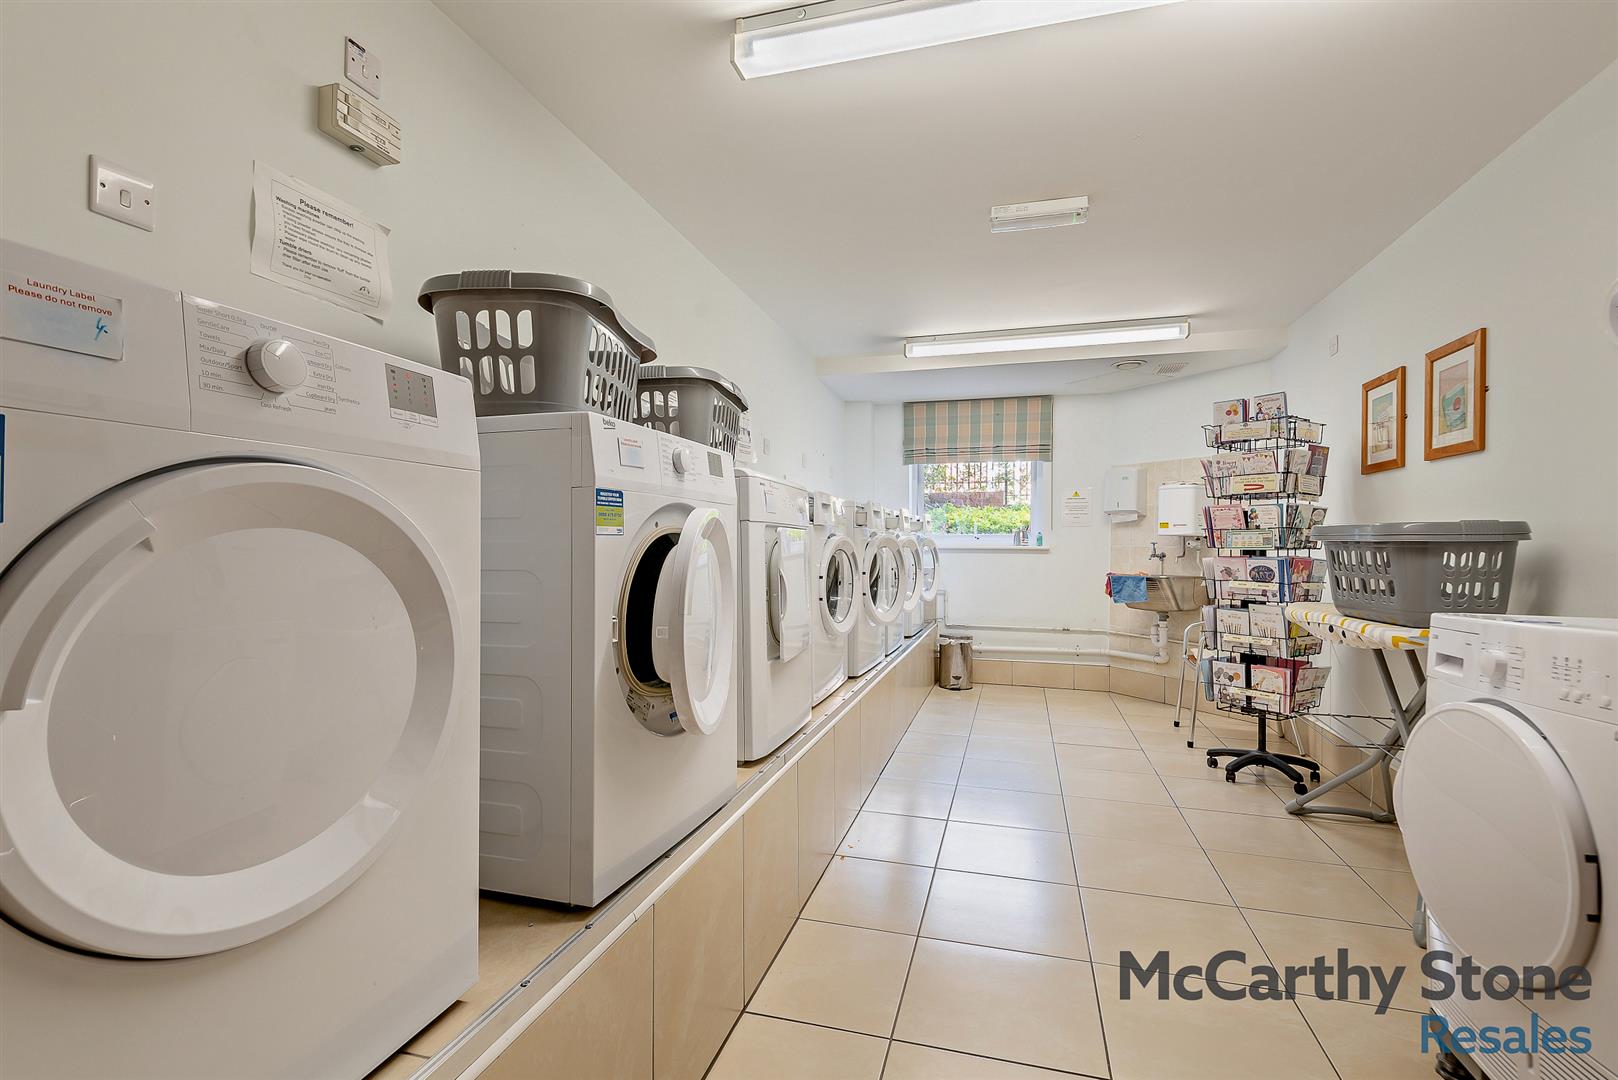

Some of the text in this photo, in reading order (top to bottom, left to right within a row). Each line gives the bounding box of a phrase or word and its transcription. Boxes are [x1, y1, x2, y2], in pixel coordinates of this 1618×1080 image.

[276, 195, 297, 209] Washing
[299, 198, 321, 213] Please
[322, 210, 354, 228] remember!
[279, 238, 297, 249] Tumble
[27, 278, 96, 302] Laundry Label
[8, 285, 113, 316] Please do not remove
[200, 331, 221, 342] Towels
[199, 344, 226, 356] Mix/Daily
[200, 356, 243, 371] Outdoor/Sport
[602, 417, 616, 428] beko
